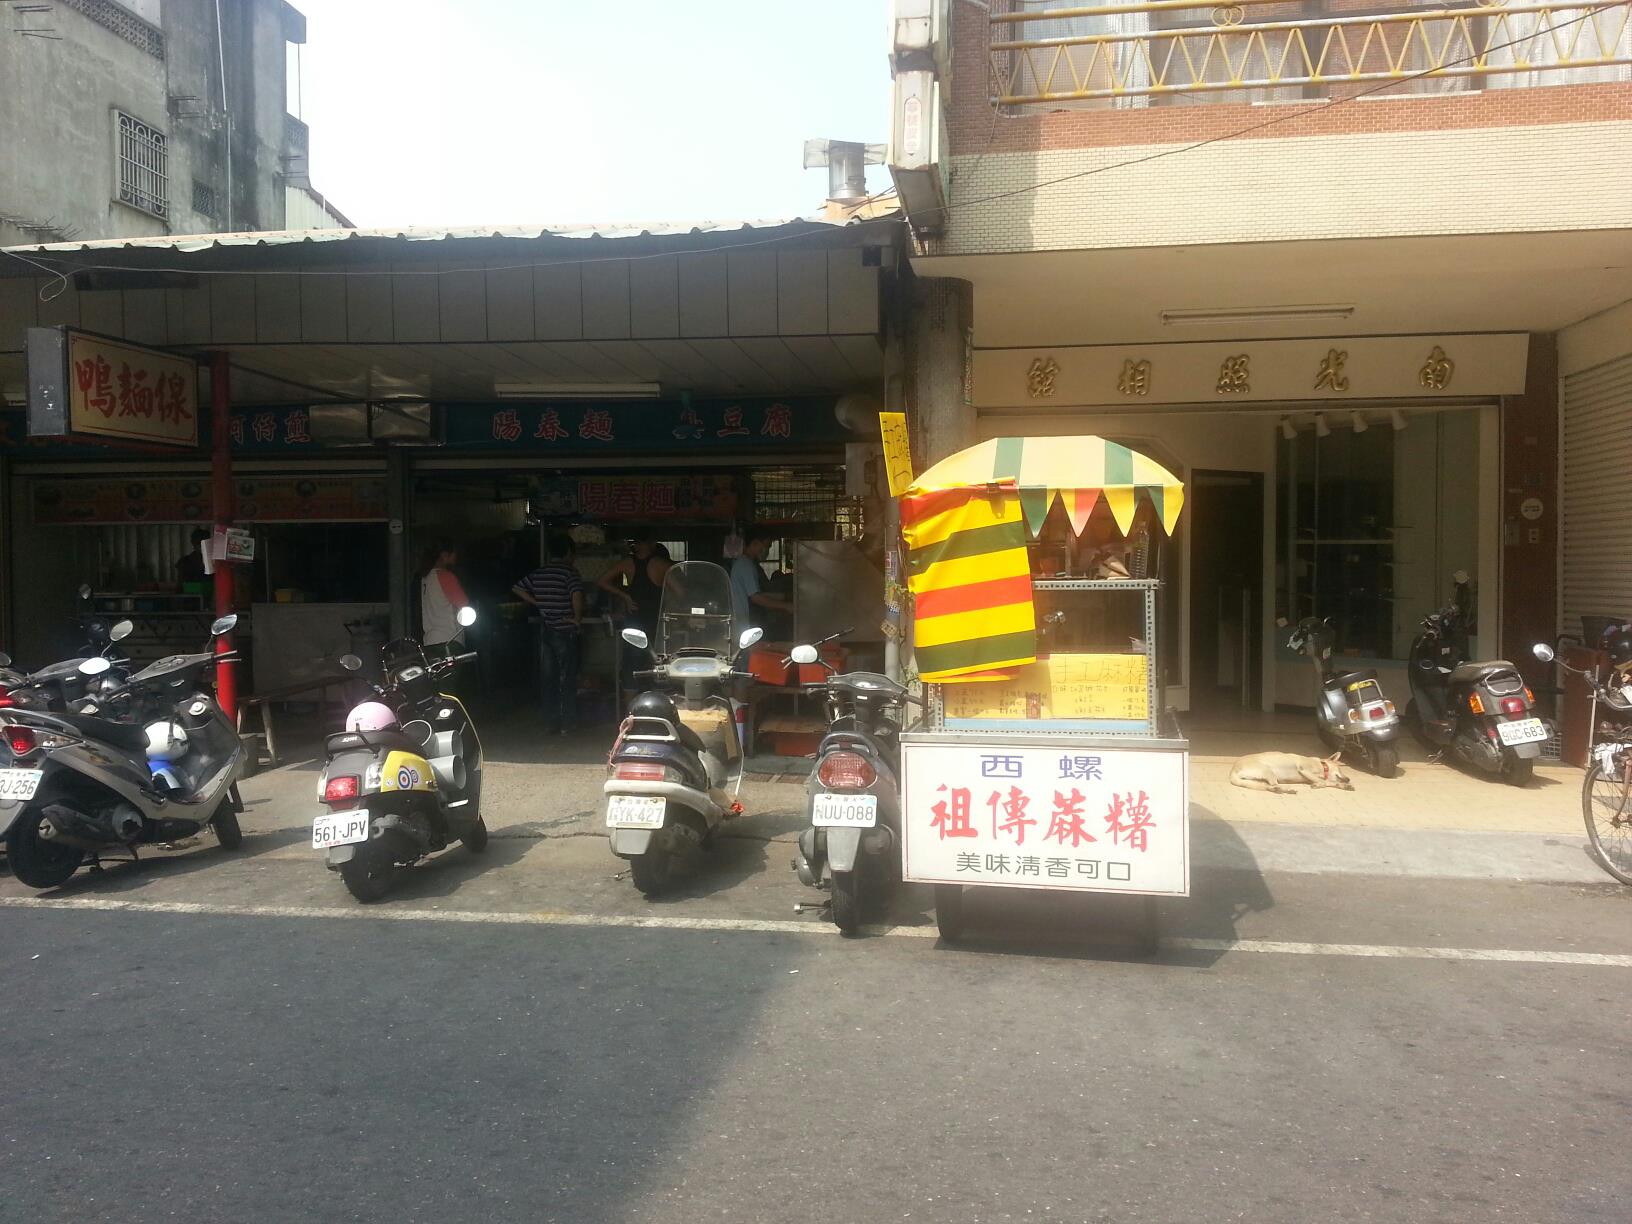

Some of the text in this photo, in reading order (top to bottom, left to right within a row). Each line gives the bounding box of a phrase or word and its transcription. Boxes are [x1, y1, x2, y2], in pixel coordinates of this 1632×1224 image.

[980, 754, 1103, 781] 西螺
[315, 820, 366, 843] 561-JPV
[956, 851, 1132, 882] 美味清香可口
